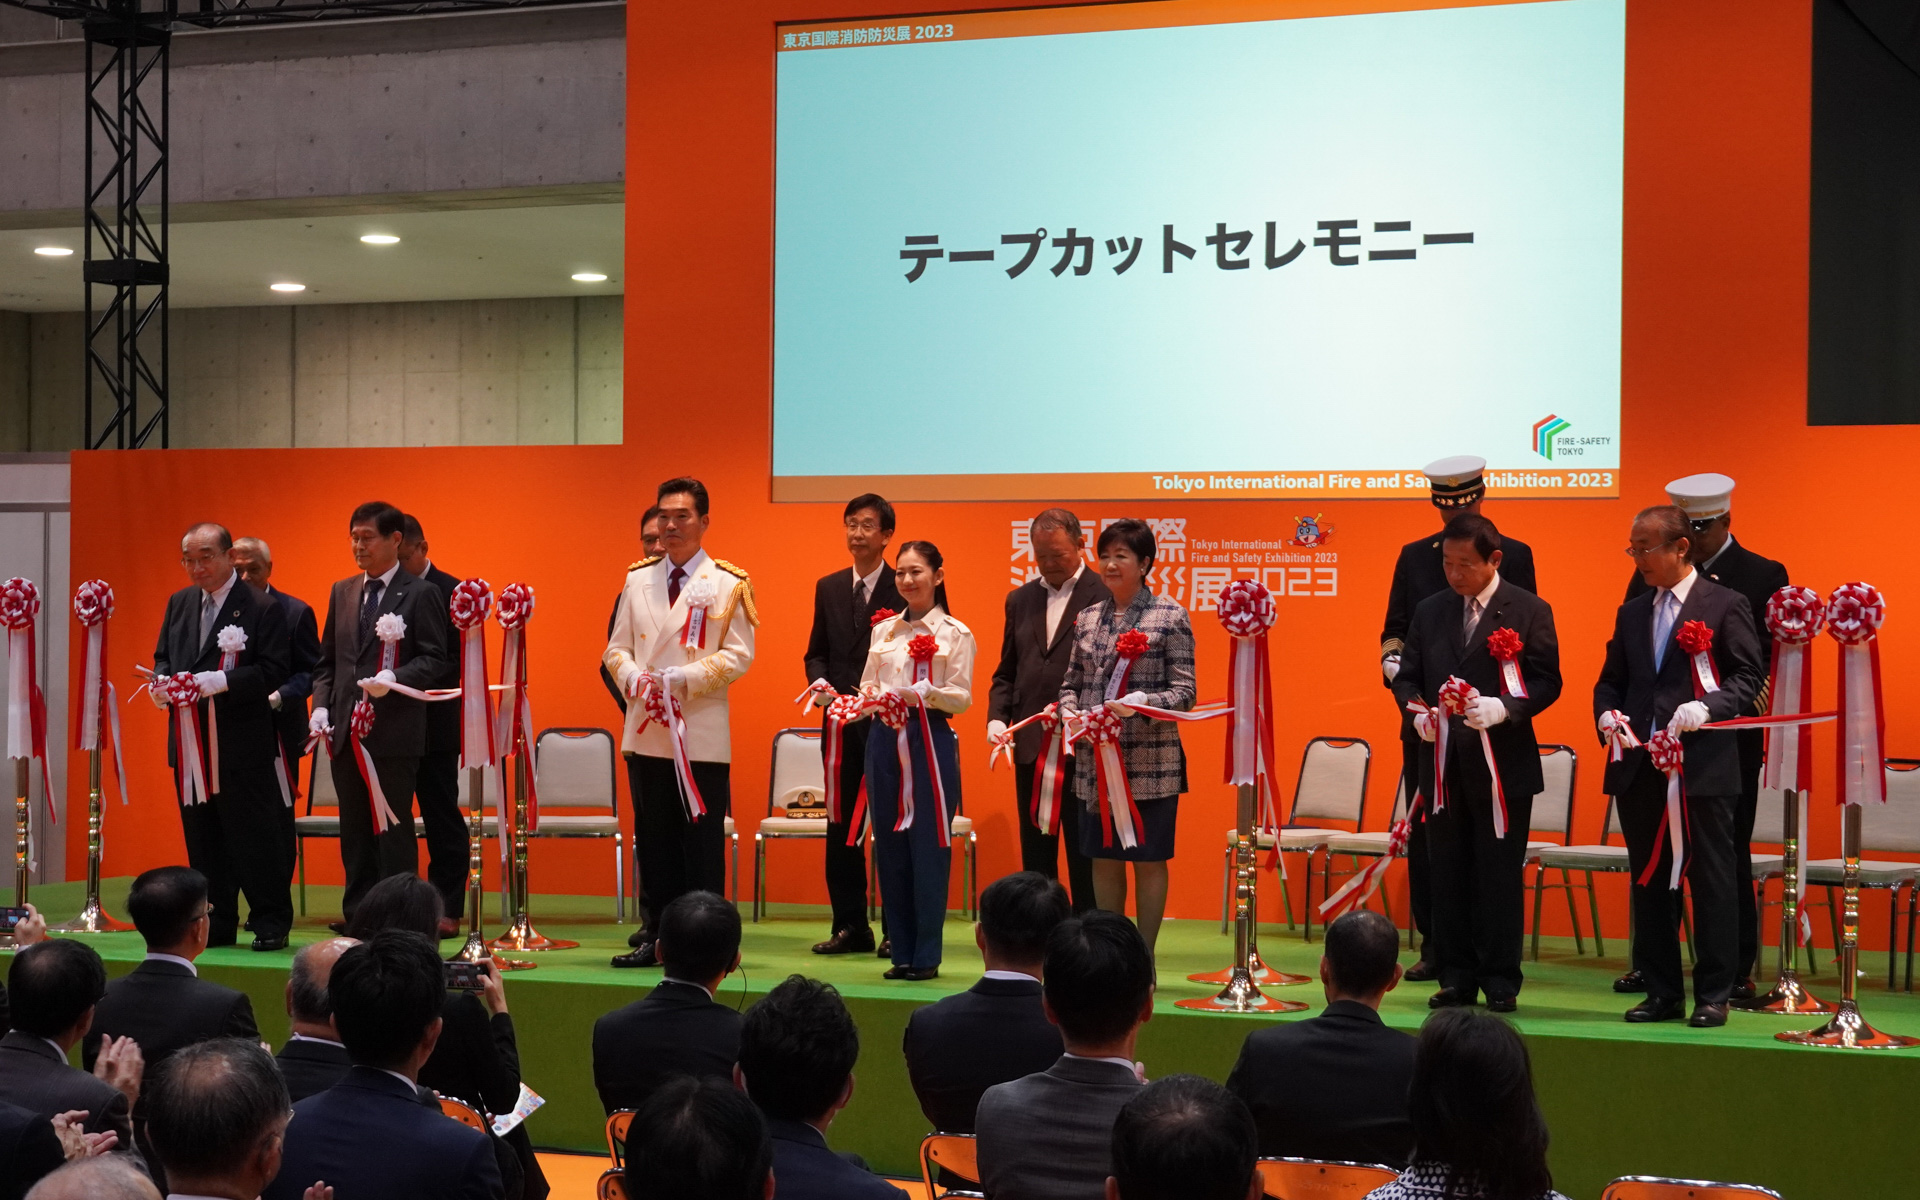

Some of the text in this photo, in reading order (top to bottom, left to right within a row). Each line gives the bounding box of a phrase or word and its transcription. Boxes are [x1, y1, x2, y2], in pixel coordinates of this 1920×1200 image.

[783, 24, 954, 49] 東京国際消防防災展 2023
[899, 218, 1475, 284] テープカットセレモニー
[1557, 447, 1584, 456] TOKYO
[1152, 474, 1206, 493] Tokyo
[1209, 473, 1325, 490] International
[1328, 473, 1362, 489] Fire
[1366, 473, 1400, 489] and
[1567, 472, 1613, 488] 2023
[1191, 538, 1282, 551] Tokyo International
[1191, 552, 1338, 565] Fire and Safety Exhibition 2023
